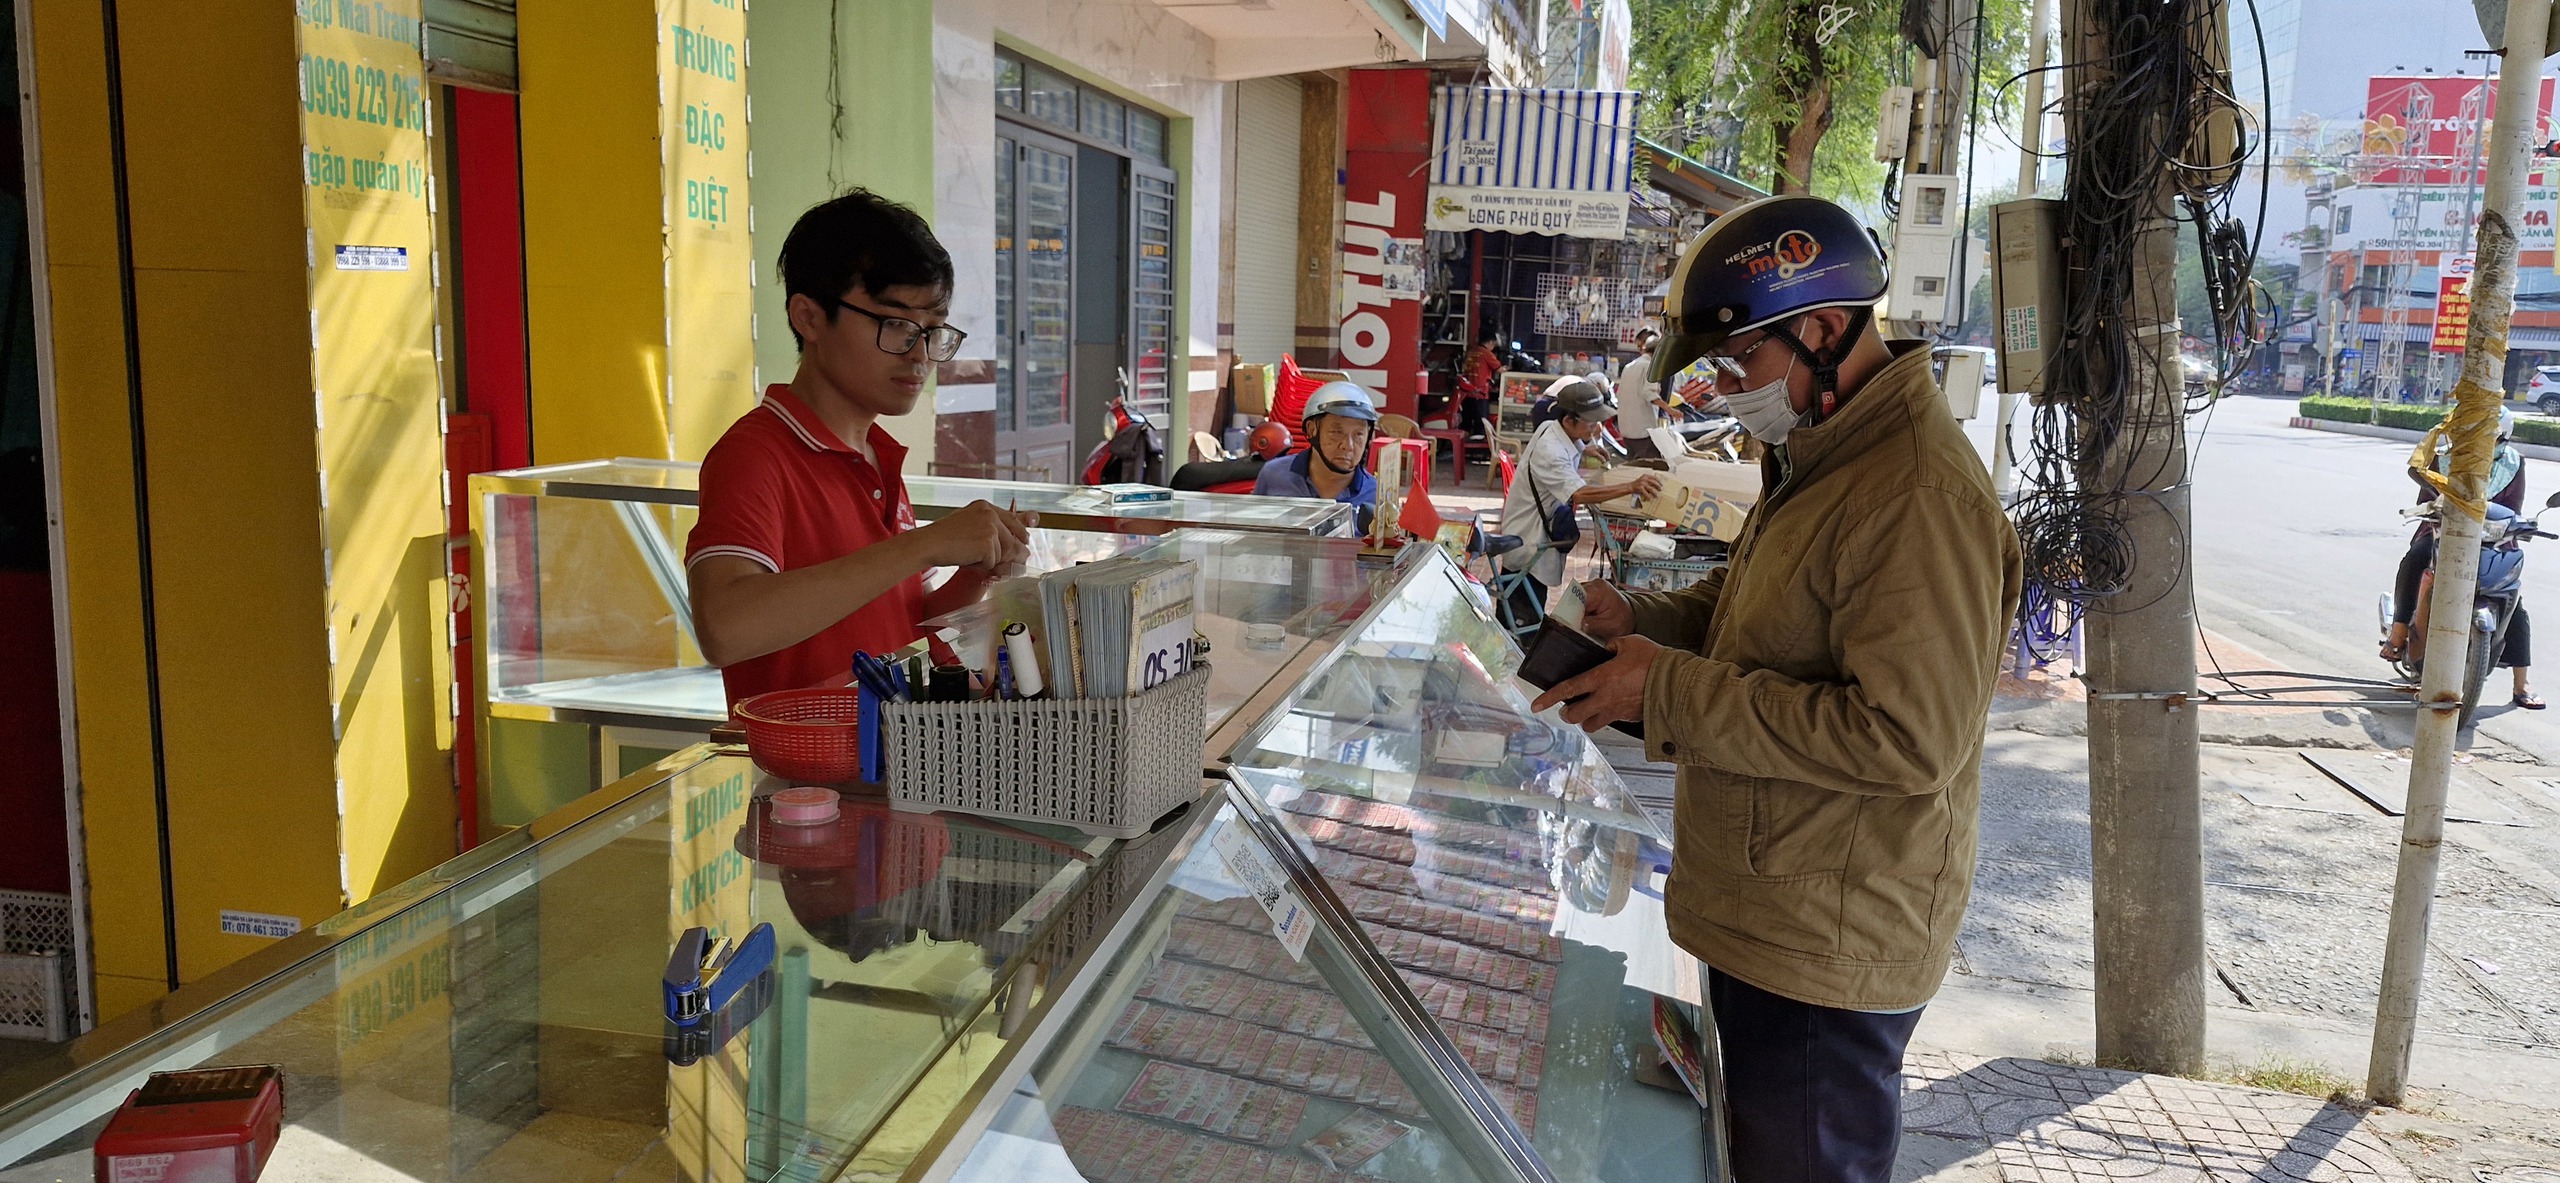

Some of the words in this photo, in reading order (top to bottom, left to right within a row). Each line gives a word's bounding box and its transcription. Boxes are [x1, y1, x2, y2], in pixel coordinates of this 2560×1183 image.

[671, 25, 736, 82] TRÚNG
[304, 53, 350, 119] 0939
[355, 64, 388, 126] 223
[392, 72, 422, 132] 215
[686, 100, 725, 155] ĐẶC
[309, 144, 346, 191] gặp
[352, 150, 400, 192] quản
[406, 159, 422, 199] lý
[687, 176, 729, 230] BIỆT
[1468, 208, 1505, 225] LONG
[1510, 207, 1539, 227] PHÚ
[1543, 208, 1572, 231] QUÝ
[1725, 241, 1772, 265] HELMET
[1748, 235, 1822, 276] moto
[236, 922, 251, 934] 078
[253, 924, 267, 936] 461
[270, 926, 288, 937] 3338
